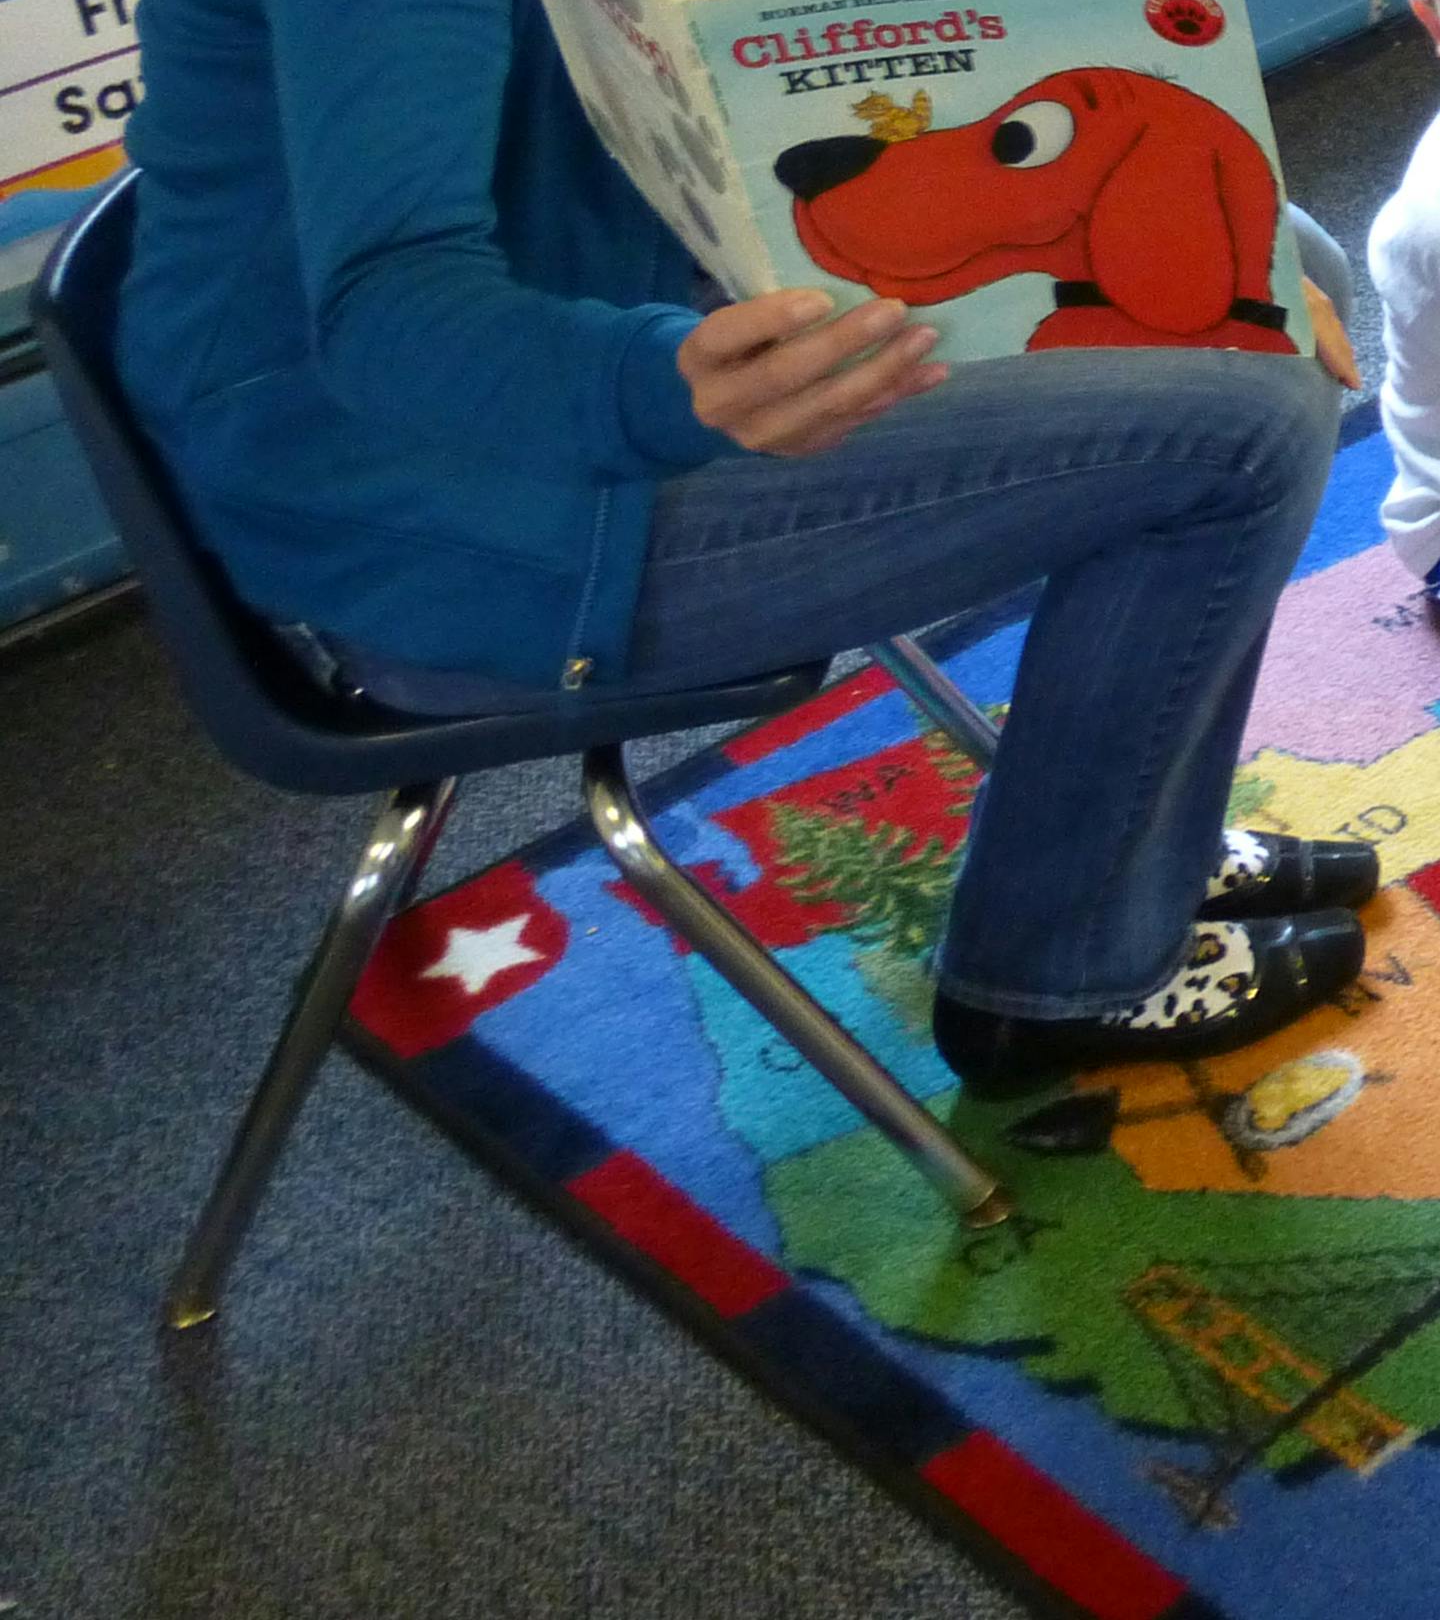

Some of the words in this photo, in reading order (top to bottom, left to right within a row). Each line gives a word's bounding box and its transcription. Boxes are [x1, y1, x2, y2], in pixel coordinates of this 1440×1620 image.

[731, 9, 1008, 69] Clifford's
[780, 48, 977, 95] KITTEN
[55, 76, 143, 134] Sa
